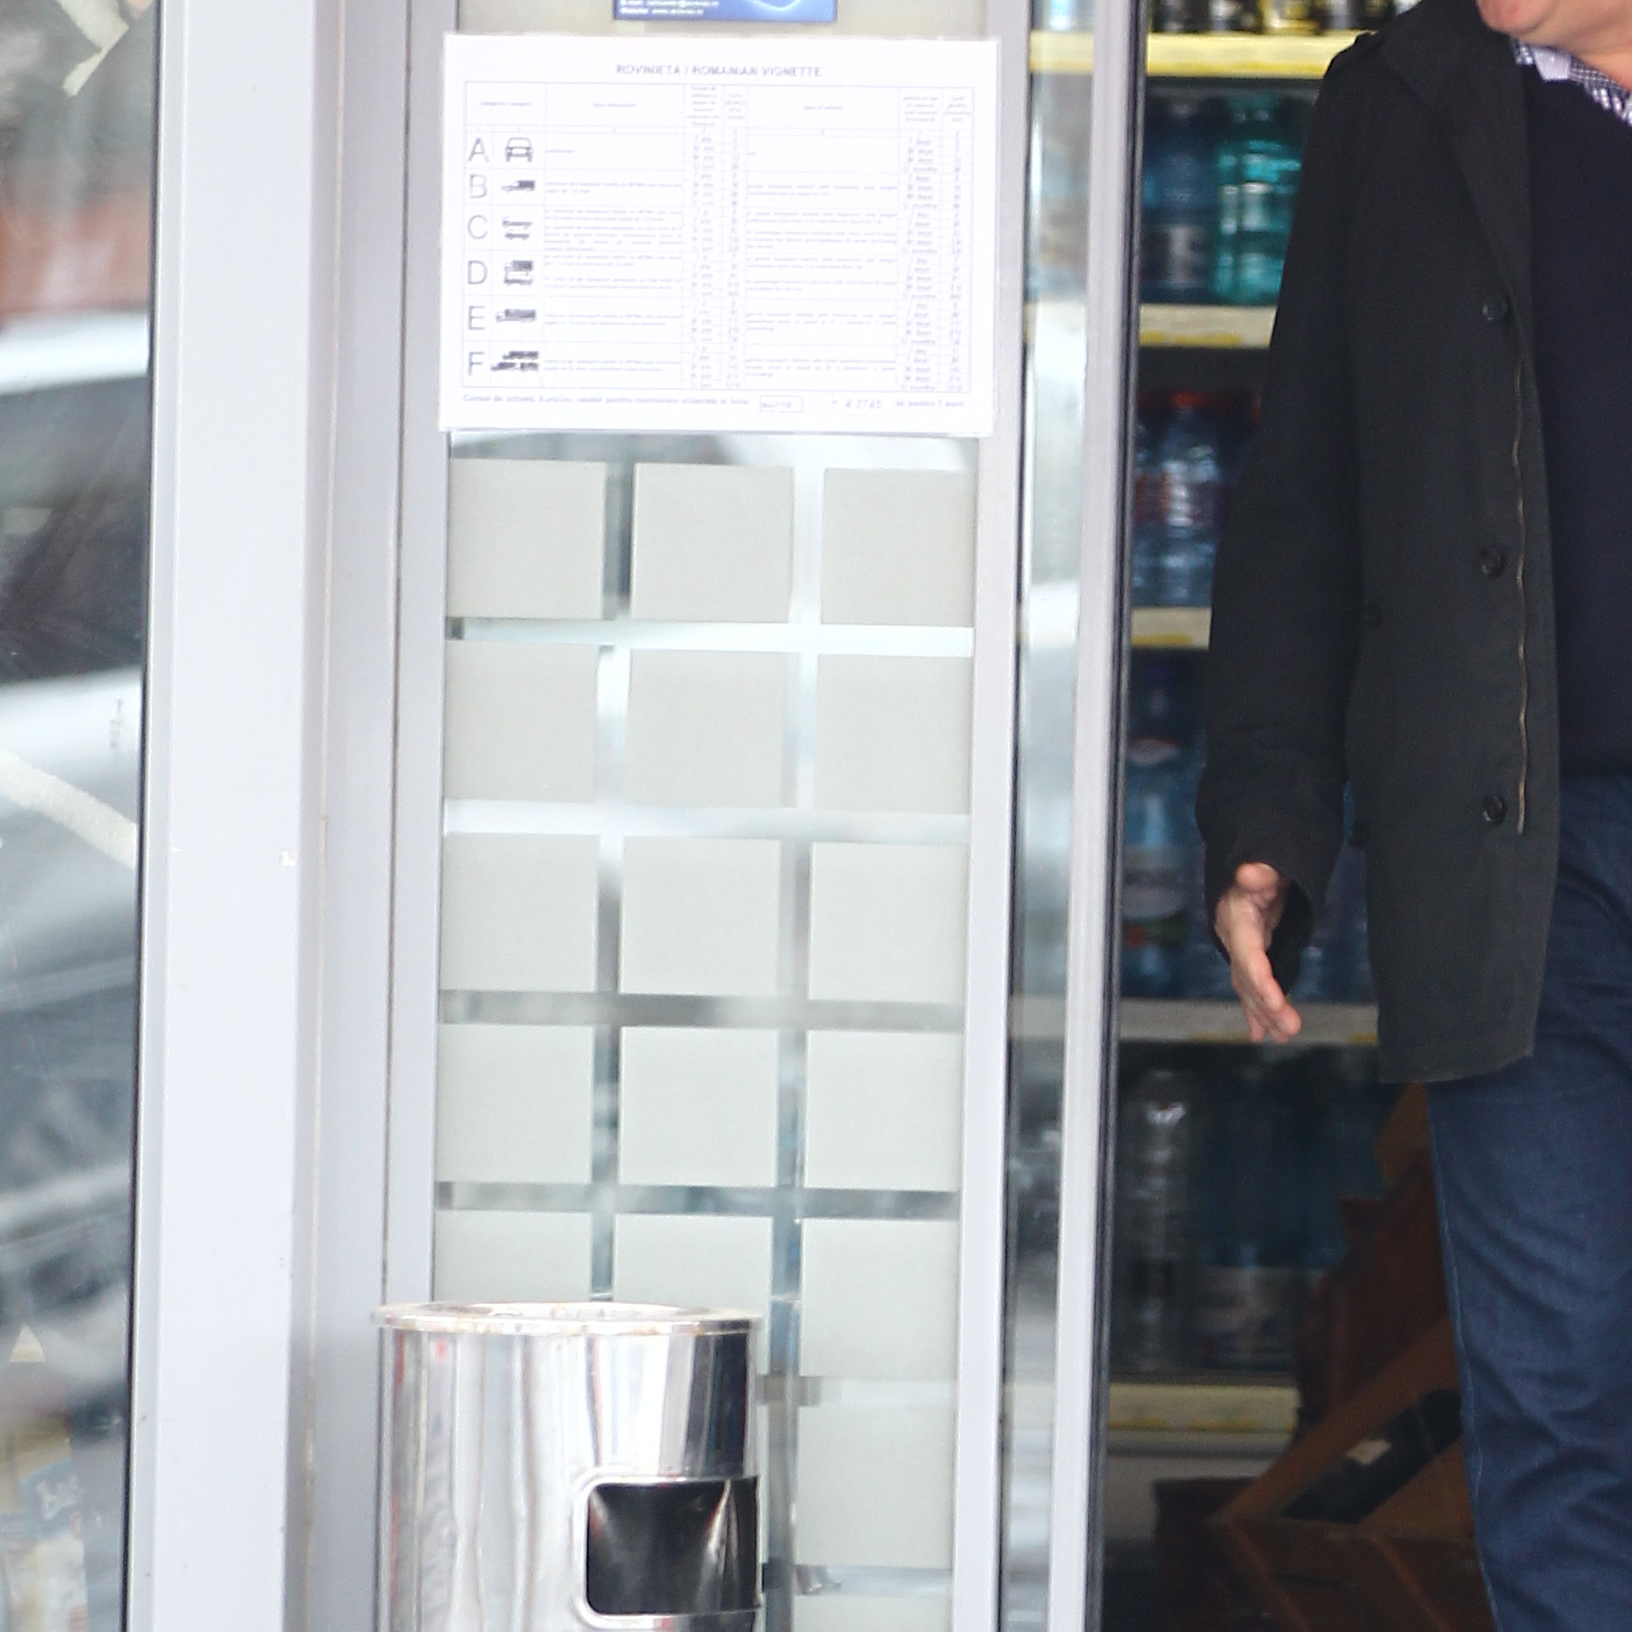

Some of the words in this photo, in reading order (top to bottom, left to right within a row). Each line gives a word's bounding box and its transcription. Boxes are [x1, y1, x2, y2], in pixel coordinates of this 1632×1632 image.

[468, 137, 490, 164] A
[469, 174, 488, 200] B
[466, 214, 489, 239] C
[468, 260, 488, 285] D
[468, 305, 487, 331] E
[468, 351, 487, 377] F
